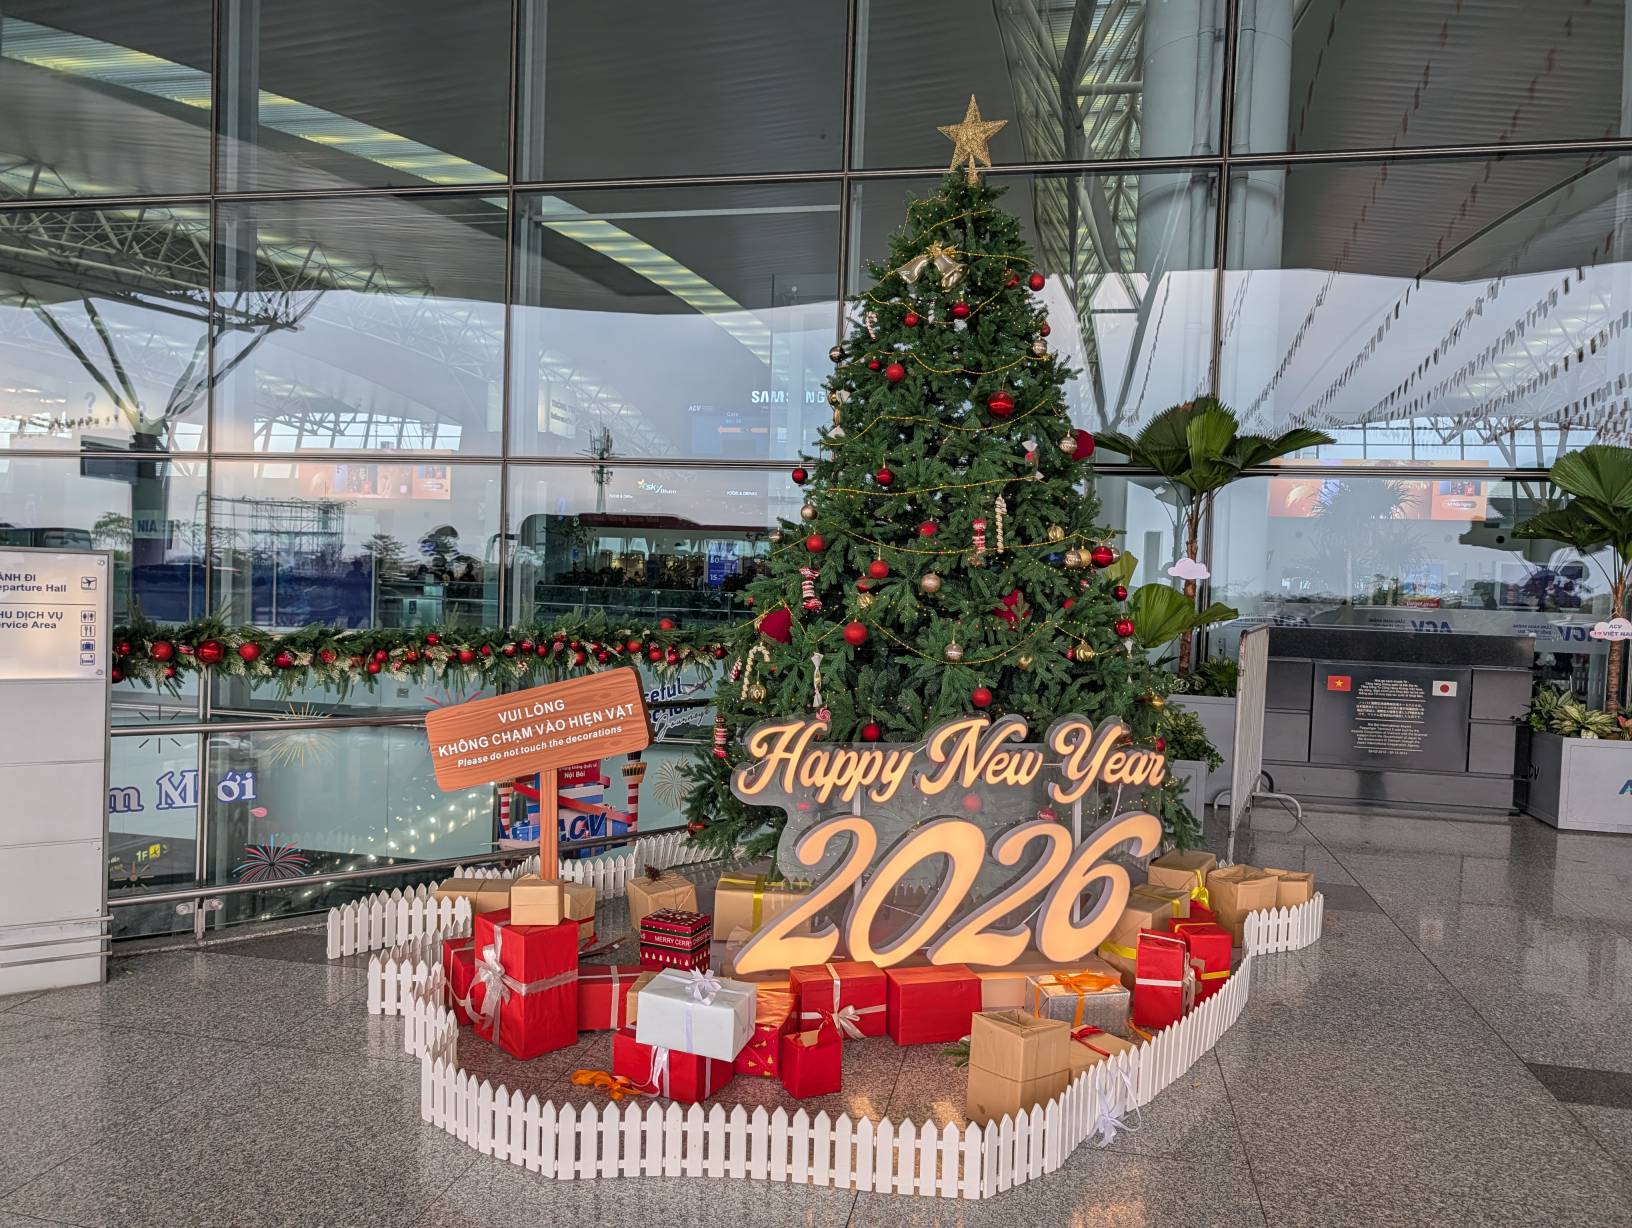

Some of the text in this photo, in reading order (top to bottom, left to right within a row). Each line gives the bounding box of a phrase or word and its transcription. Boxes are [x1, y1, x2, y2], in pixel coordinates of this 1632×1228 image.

[751, 391, 826, 403] SAMNG
[24, 573, 36, 582] ĐI
[46, 584, 67, 593] Hall
[16, 611, 44, 621] DỊCH
[48, 611, 63, 621] VỤ
[0, 621, 57, 629] rvice Area
[498, 700, 565, 724] VUI LÒNG
[438, 736, 489, 757] KHÔNG
[491, 726, 533, 746] CHẠM
[535, 718, 566, 736] VÀO
[569, 710, 603, 730] HIỆN
[605, 703, 634, 721] VẬT
[457, 725, 623, 768] Please do not touch the decorations
[737, 715, 1167, 804] Happy New Year
[136, 850, 148, 863] 1F
[733, 812, 1163, 975] 2026
[654, 935, 674, 944] MERRY
